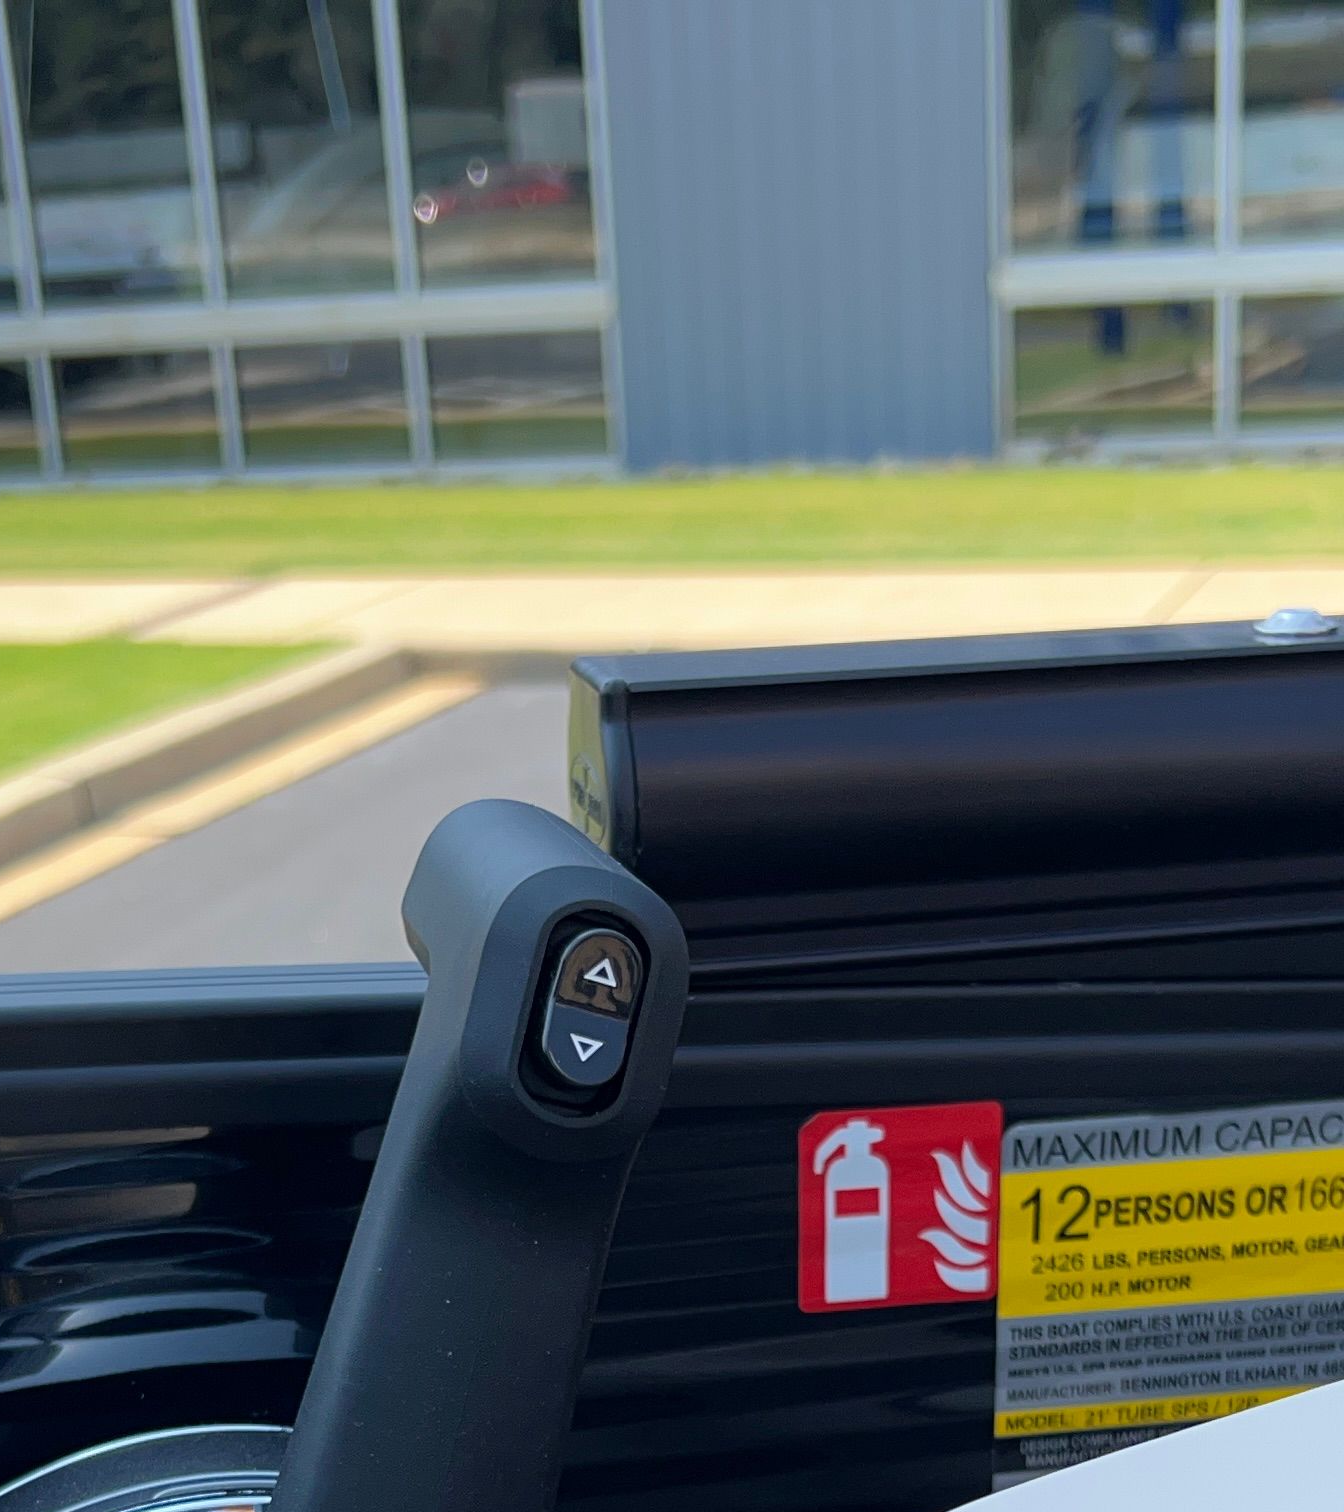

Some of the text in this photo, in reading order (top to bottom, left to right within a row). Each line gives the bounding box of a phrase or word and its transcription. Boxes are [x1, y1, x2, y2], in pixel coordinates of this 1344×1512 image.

[1012, 1125, 1202, 1168] MAXIMUM
[1020, 1184, 1091, 1244] 12
[1094, 1188, 1236, 1229] PERSONS
[1244, 1184, 1288, 1216] OR
[1031, 1253, 1086, 1275] 2426
[1045, 1281, 1085, 1302] 200
[1127, 1274, 1192, 1294] MOTOR
[1008, 1339, 1102, 1361] STANDARDS
[1107, 1337, 1121, 1353] IN
[1124, 1331, 1186, 1351] EFFECT
[1186, 1329, 1210, 1345] ON
[1215, 1326, 1244, 1343] THE
[1247, 1322, 1287, 1340] DATE
[1291, 1319, 1311, 1336] OF
[1010, 1325, 1044, 1343] THIS
[1047, 1321, 1089, 1340] BOAT
[1092, 1314, 1172, 1335] COMPLIES
[1176, 1309, 1215, 1328] WITH
[1250, 1303, 1304, 1322] COAST
[1119, 1371, 1221, 1394] BENNINGTON
[1303, 1363, 1318, 1377] IN
[1116, 1403, 1164, 1422] TUBE
